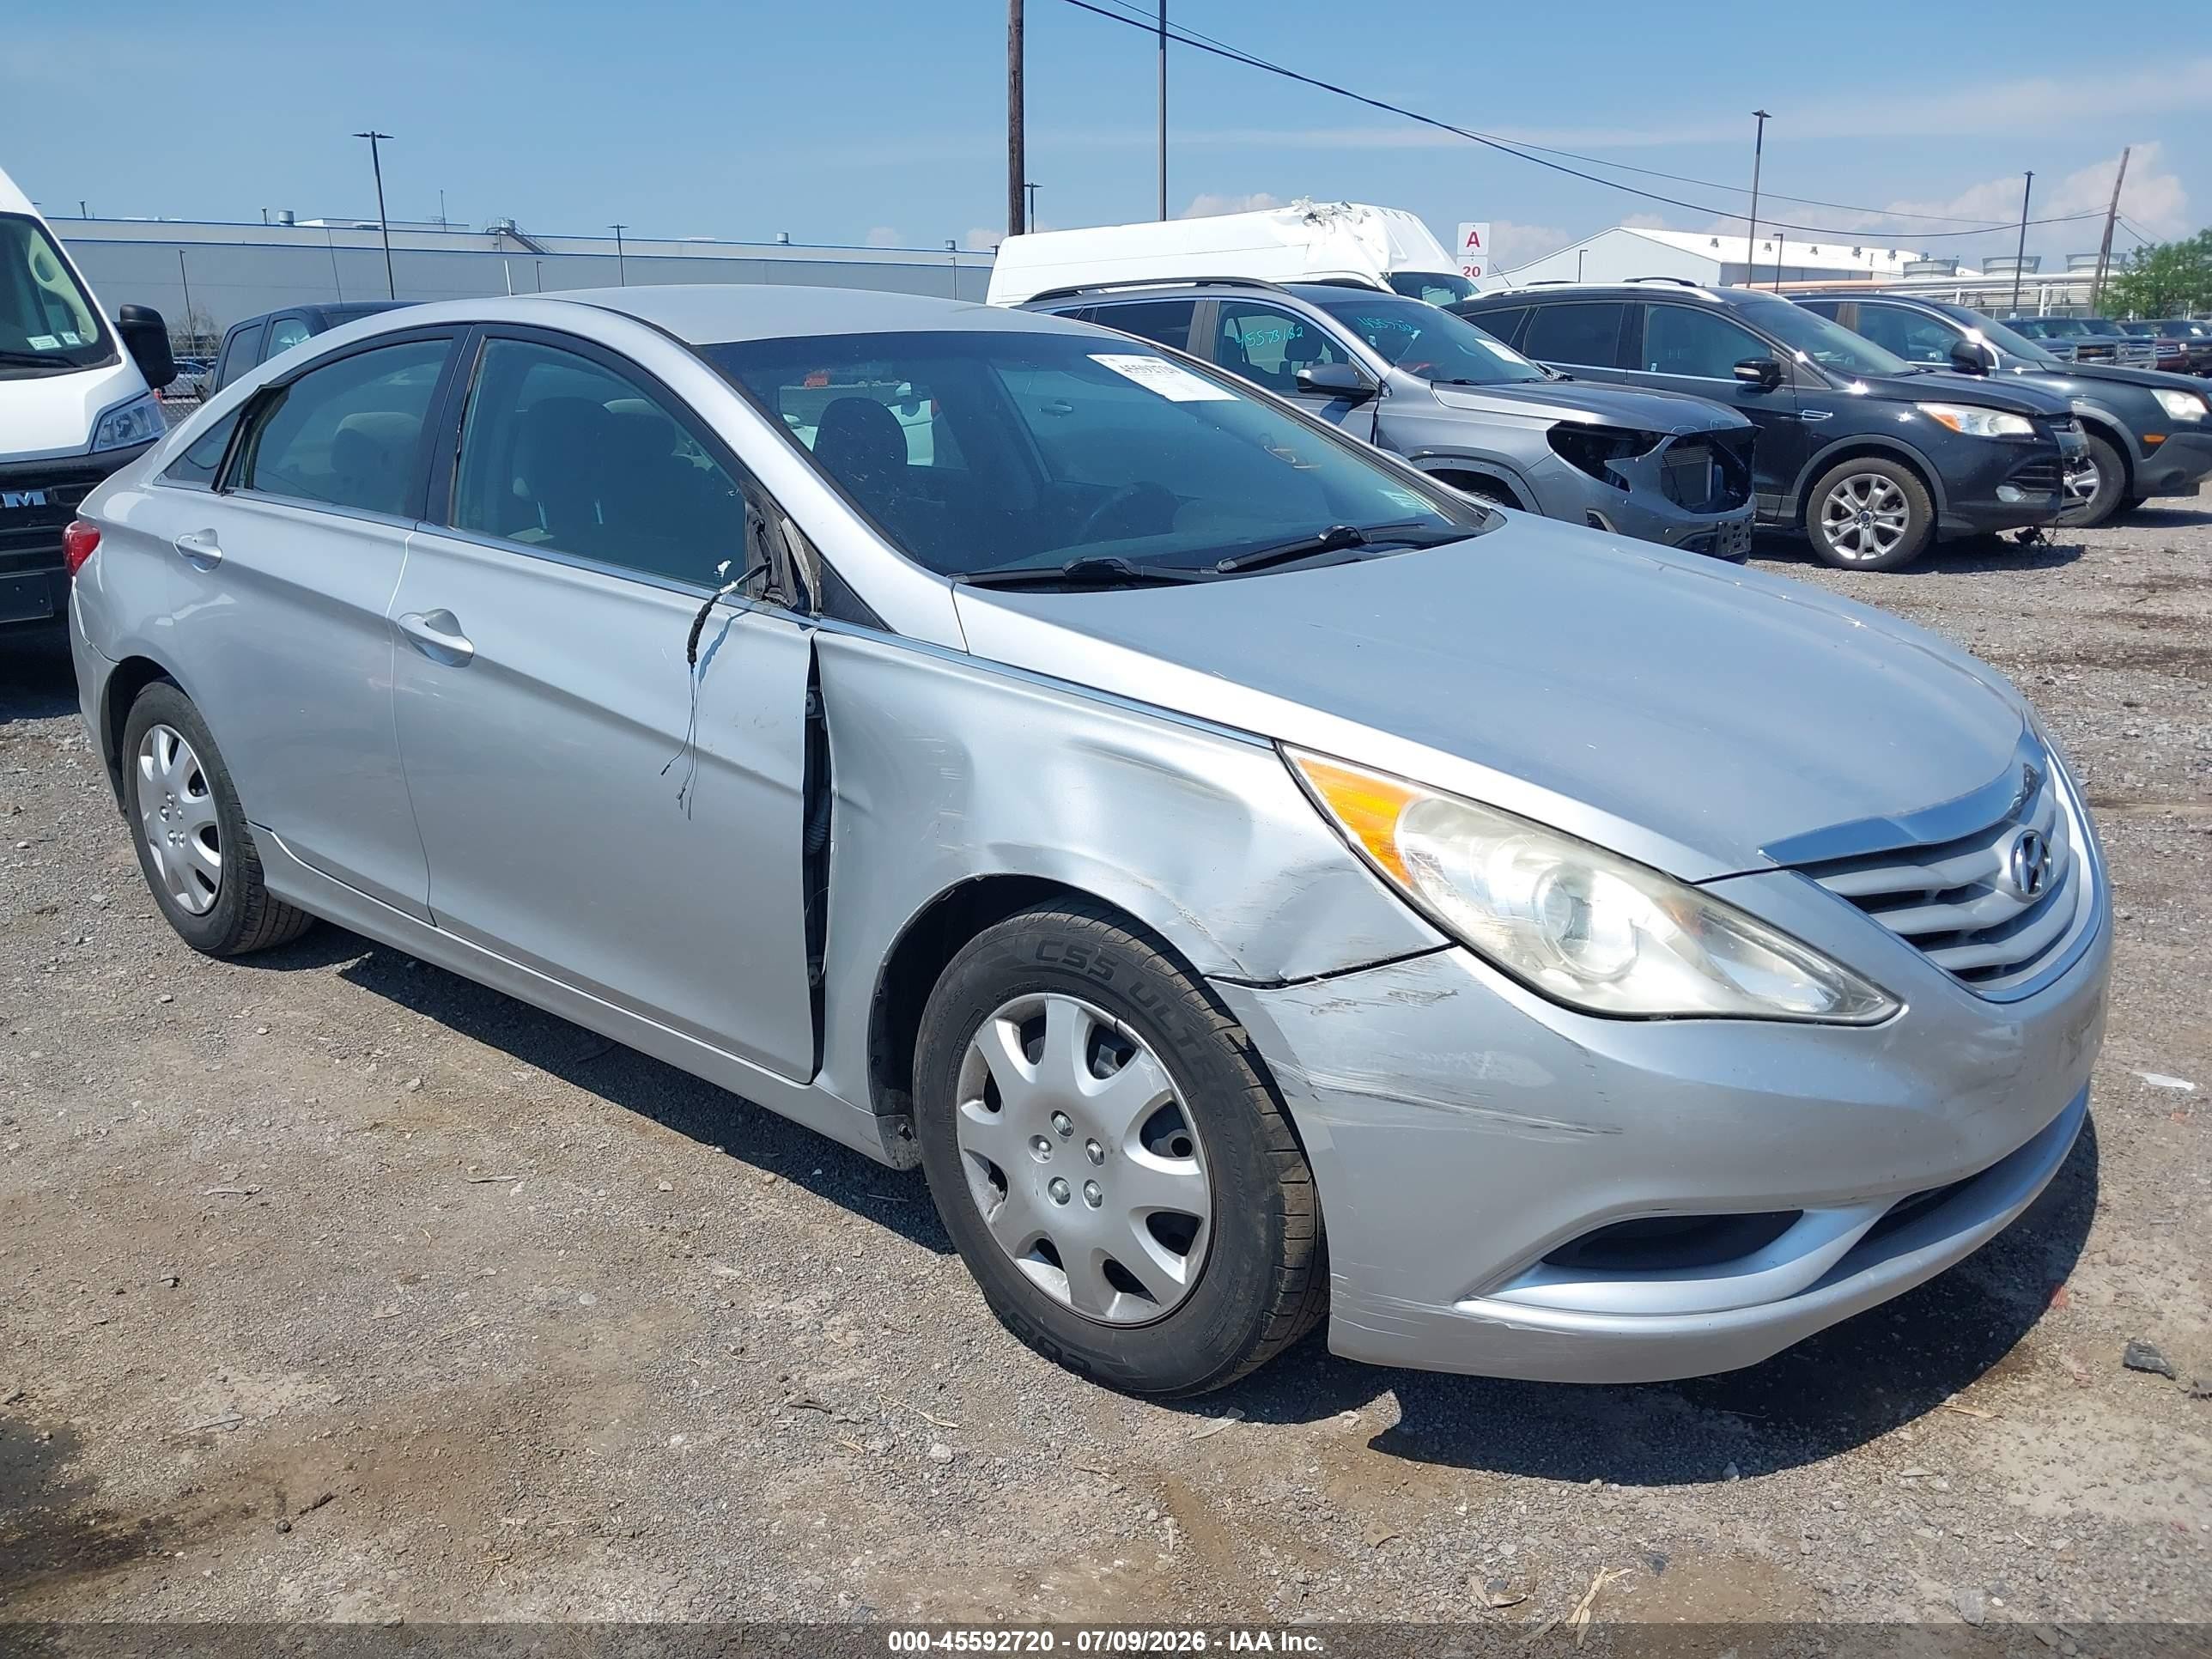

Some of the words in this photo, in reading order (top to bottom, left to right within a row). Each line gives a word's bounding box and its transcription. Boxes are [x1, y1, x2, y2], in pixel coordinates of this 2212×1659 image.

[1466, 232, 1480, 247] A
[1462, 266, 1480, 277] 20
[1235, 326, 1304, 349] 45573182
[0, 491, 46, 508] M
[1036, 939, 1119, 981] CS5
